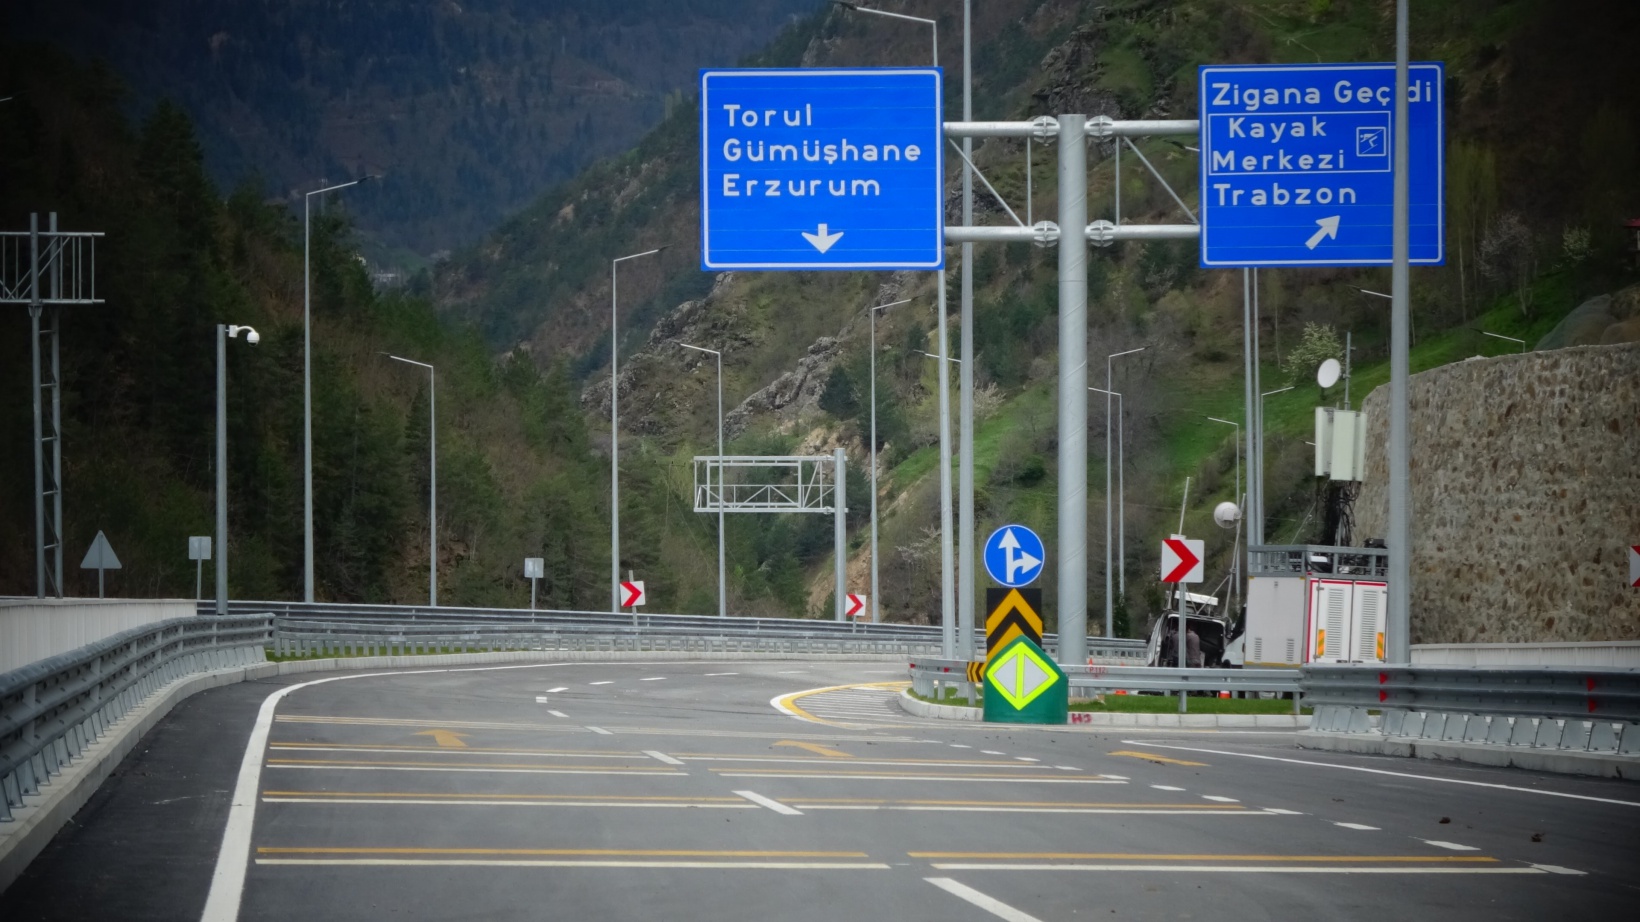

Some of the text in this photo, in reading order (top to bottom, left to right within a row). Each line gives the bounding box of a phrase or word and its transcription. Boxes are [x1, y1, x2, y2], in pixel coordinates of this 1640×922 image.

[1212, 80, 1431, 111] Zigana Geçdi
[723, 103, 812, 127] Torul
[1229, 116, 1327, 143] Kayak
[723, 138, 921, 165] Gümüşhane
[1212, 149, 1344, 172] Merkezi
[723, 173, 881, 197] Erzurum
[1213, 182, 1356, 206] Trabzon
